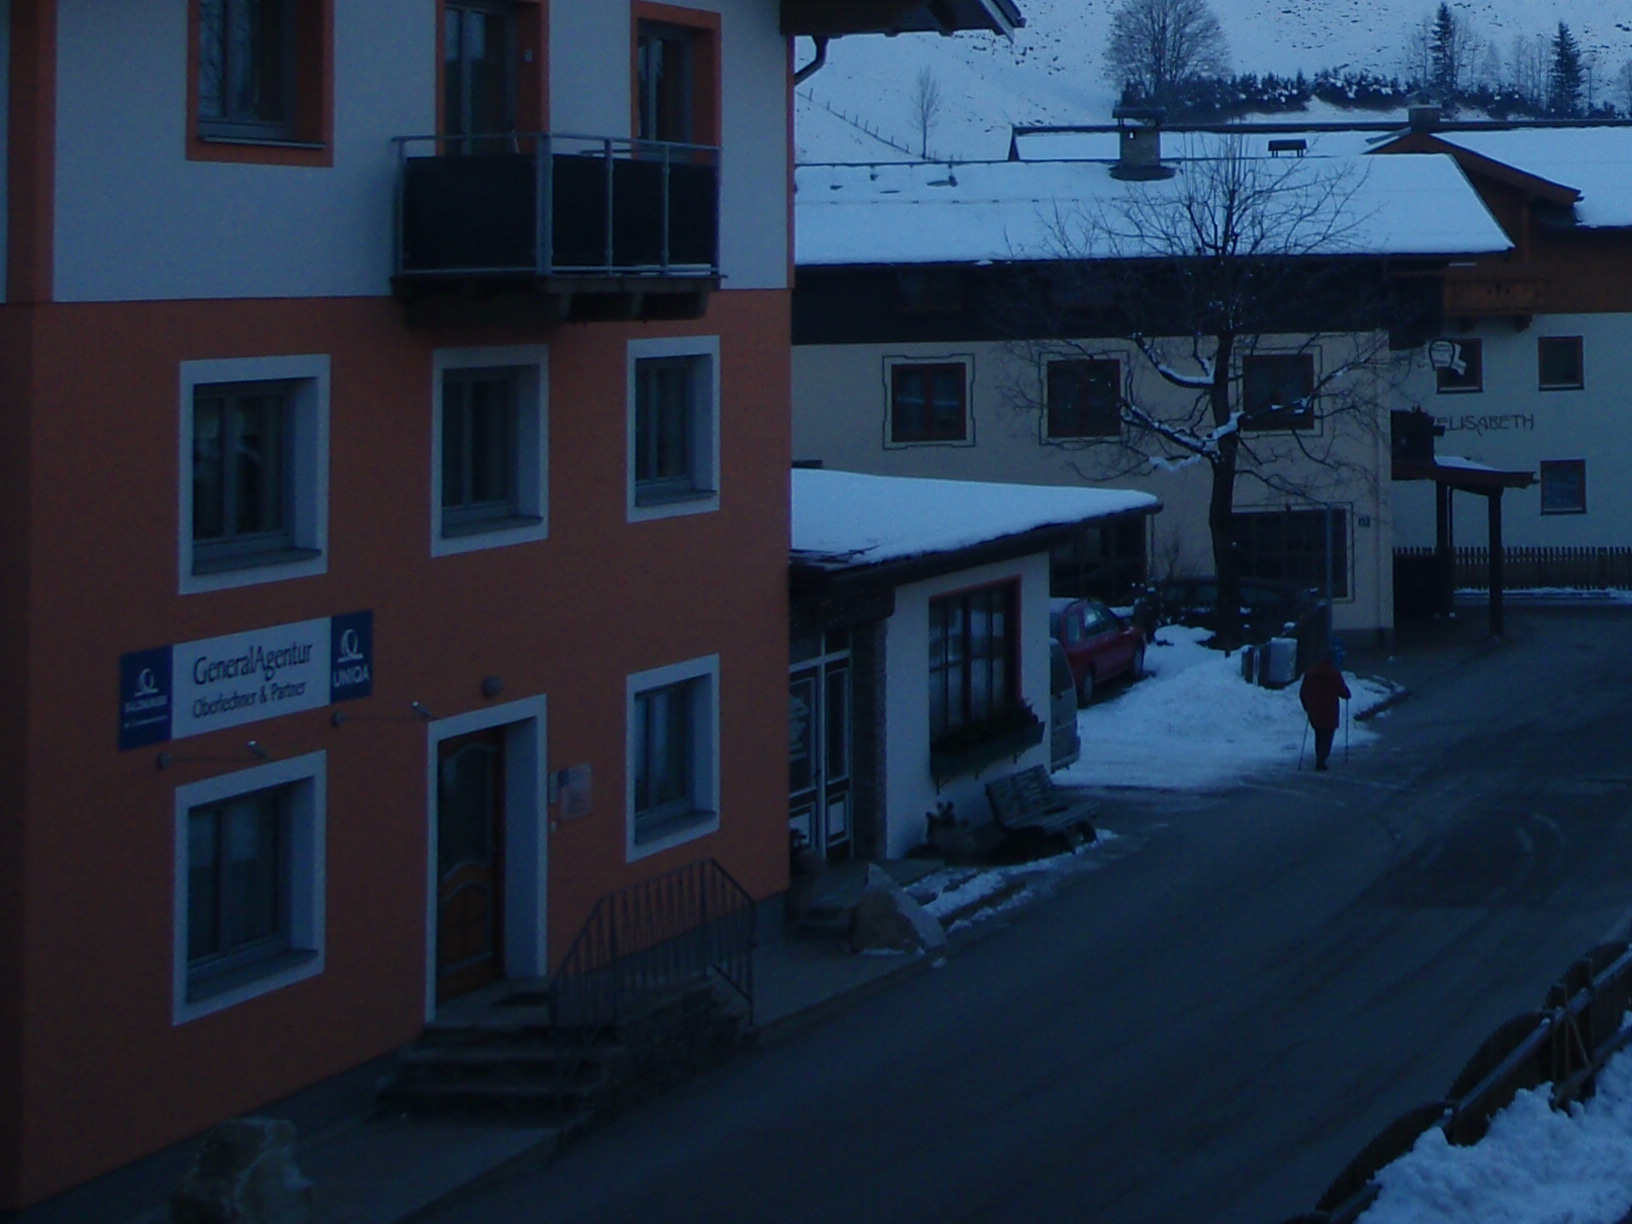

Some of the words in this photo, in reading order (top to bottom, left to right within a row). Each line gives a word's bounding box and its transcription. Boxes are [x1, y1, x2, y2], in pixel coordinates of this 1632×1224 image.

[1436, 413, 1535, 436] ELISABETH
[193, 641, 313, 685] GeneralAgentur
[333, 664, 370, 688] UNIQA
[259, 686, 268, 704] &
[271, 680, 307, 702] Partner
